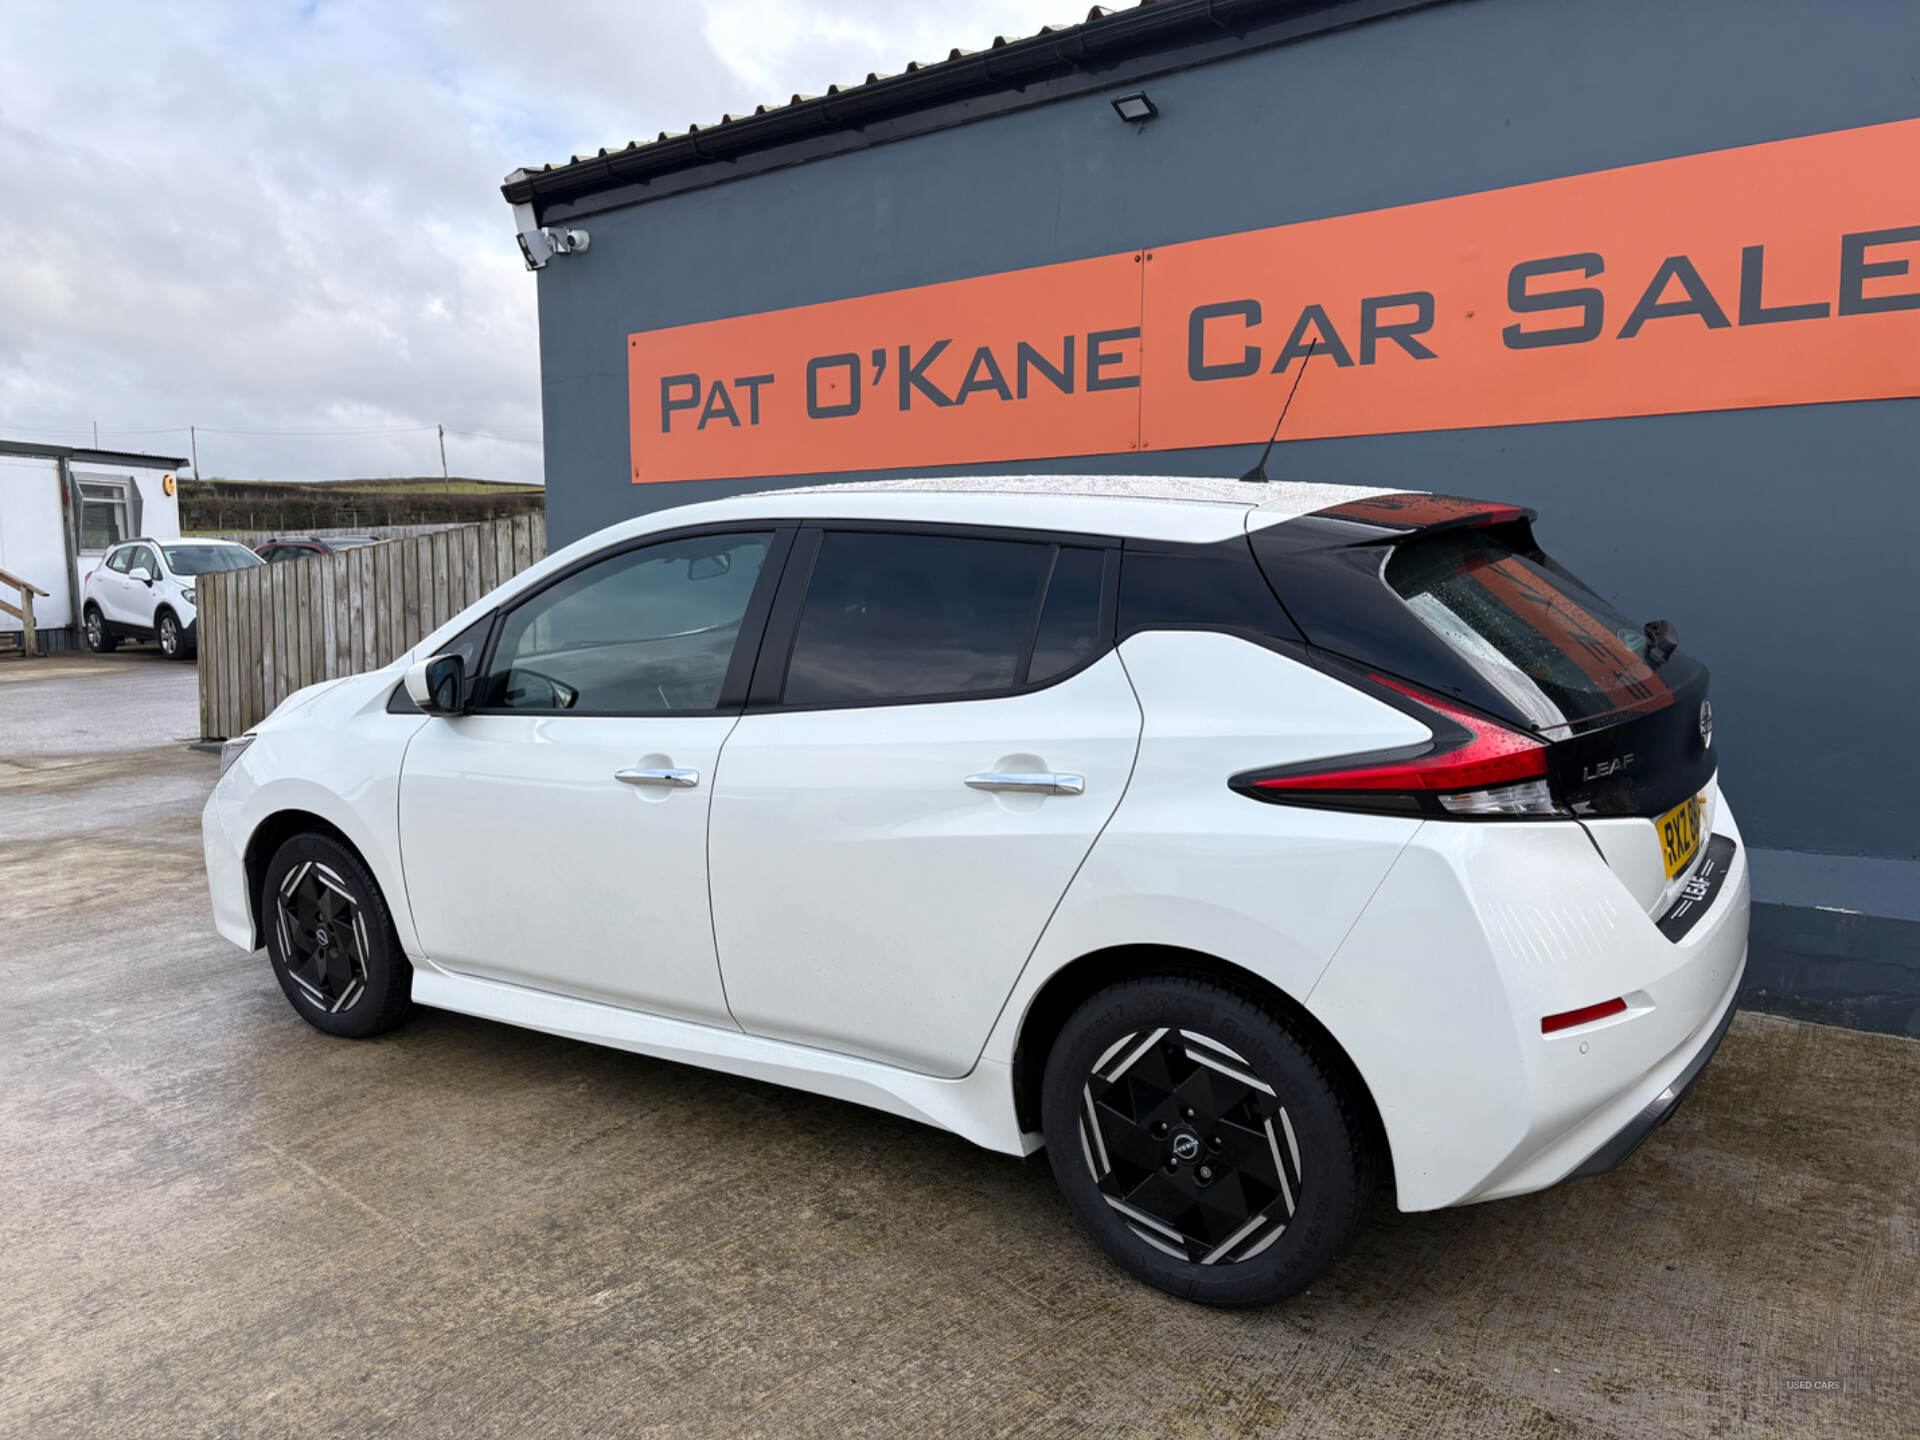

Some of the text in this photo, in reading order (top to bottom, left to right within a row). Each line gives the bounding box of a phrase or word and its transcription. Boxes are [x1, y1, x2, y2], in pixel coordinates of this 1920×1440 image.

[661, 226, 1920, 433] PAT O'KANE CAR SALE
[1583, 753, 1635, 782] LEAF
[1681, 874, 1711, 902] LEAF
